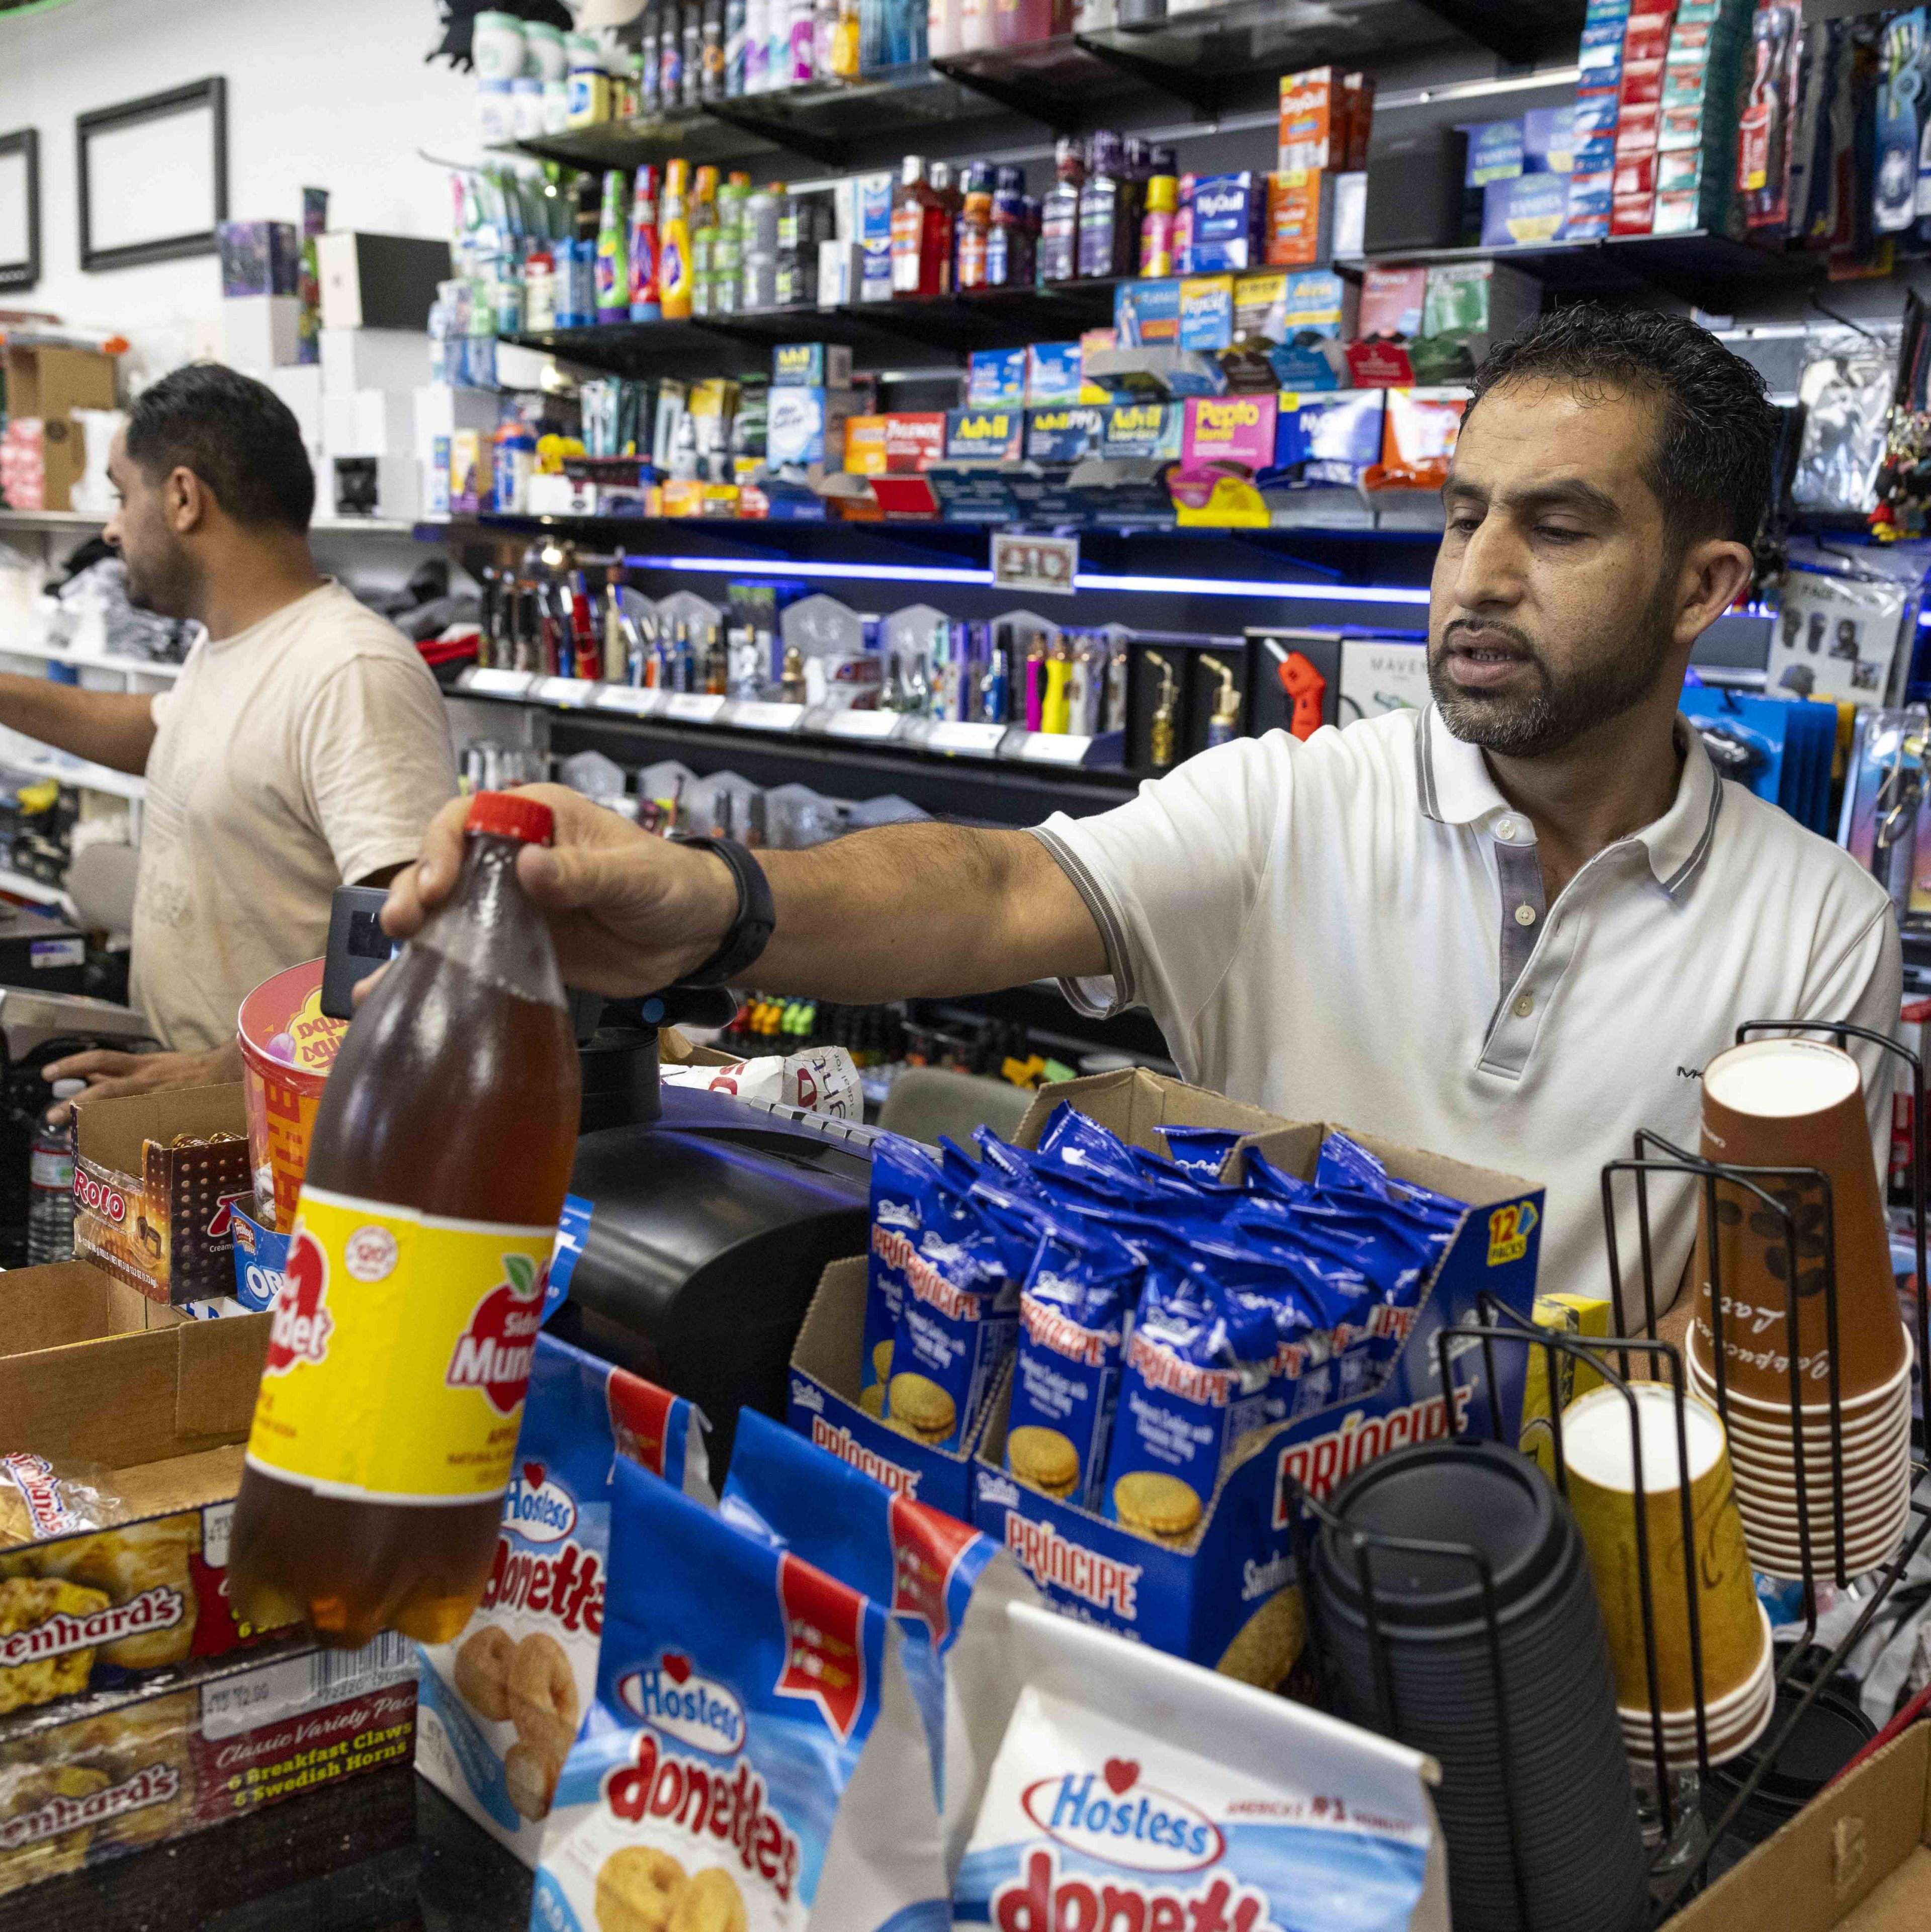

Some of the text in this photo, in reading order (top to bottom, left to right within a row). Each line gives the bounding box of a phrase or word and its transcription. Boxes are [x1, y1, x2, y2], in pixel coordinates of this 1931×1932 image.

[957, 414, 1009, 440] Advil
[1197, 400, 1259, 431] Pepto
[100, 1247, 109, 1261] ROLLS
[210, 1244, 234, 1252] Creamy
[1493, 1210, 1516, 1245] 12
[503, 1476, 570, 1531] Hostess
[642, 1668, 739, 1742] Hostess
[215, 1731, 294, 1769] Classic
[296, 1709, 370, 1744] Variety
[246, 1740, 349, 1785] Breakfast
[353, 1721, 413, 1750] Claws
[252, 1761, 342, 1803] Swedish
[346, 1741, 407, 1773] Horns
[607, 1734, 798, 1904] donettes
[1048, 1772, 1207, 1857] Hostess
